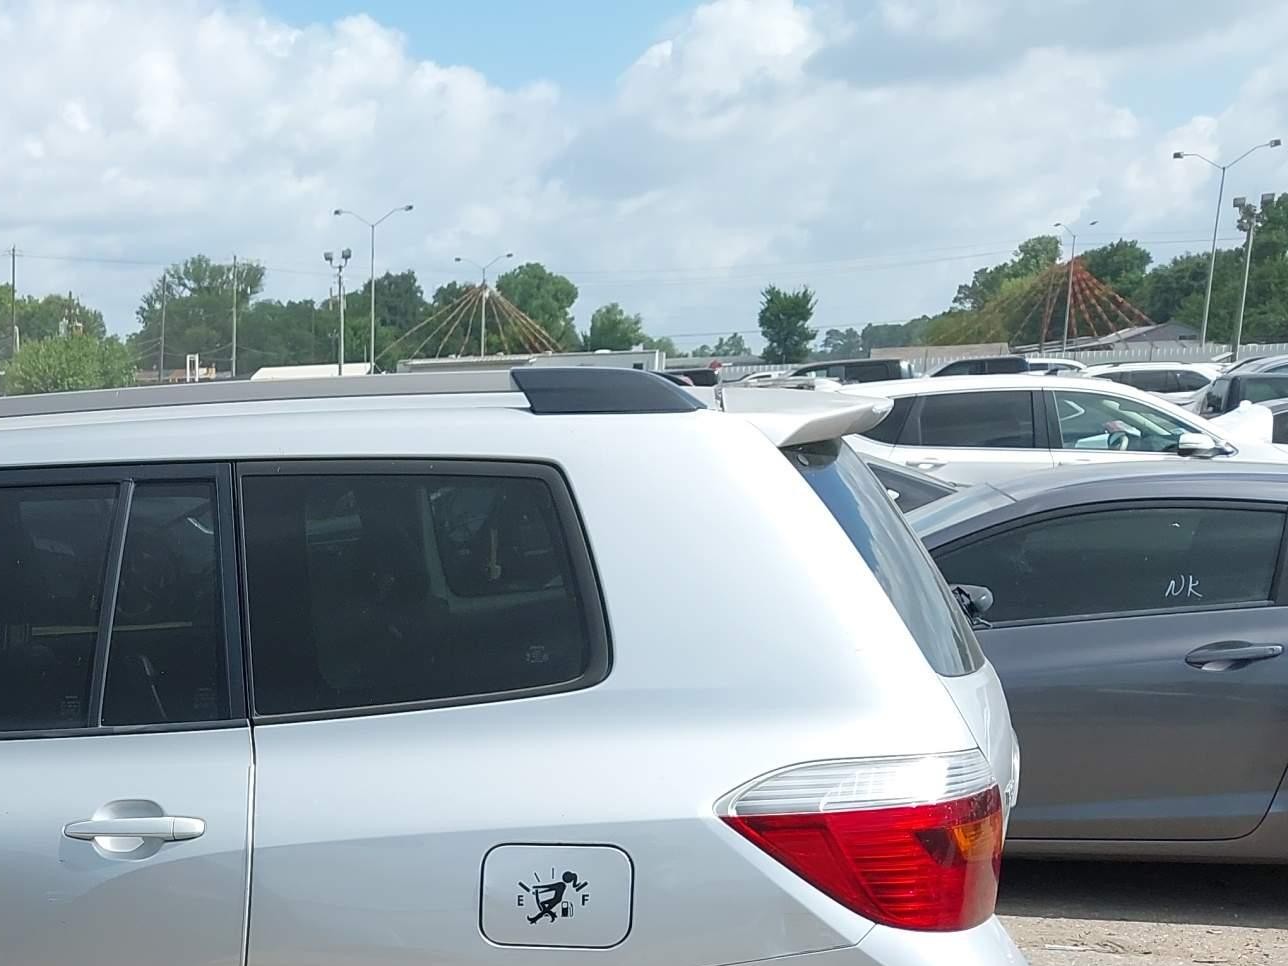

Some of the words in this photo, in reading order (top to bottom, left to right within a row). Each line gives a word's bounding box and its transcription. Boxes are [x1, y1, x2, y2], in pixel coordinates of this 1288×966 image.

[1165, 574, 1203, 597] NK
[517, 895, 524, 907] E
[582, 894, 590, 906] F
